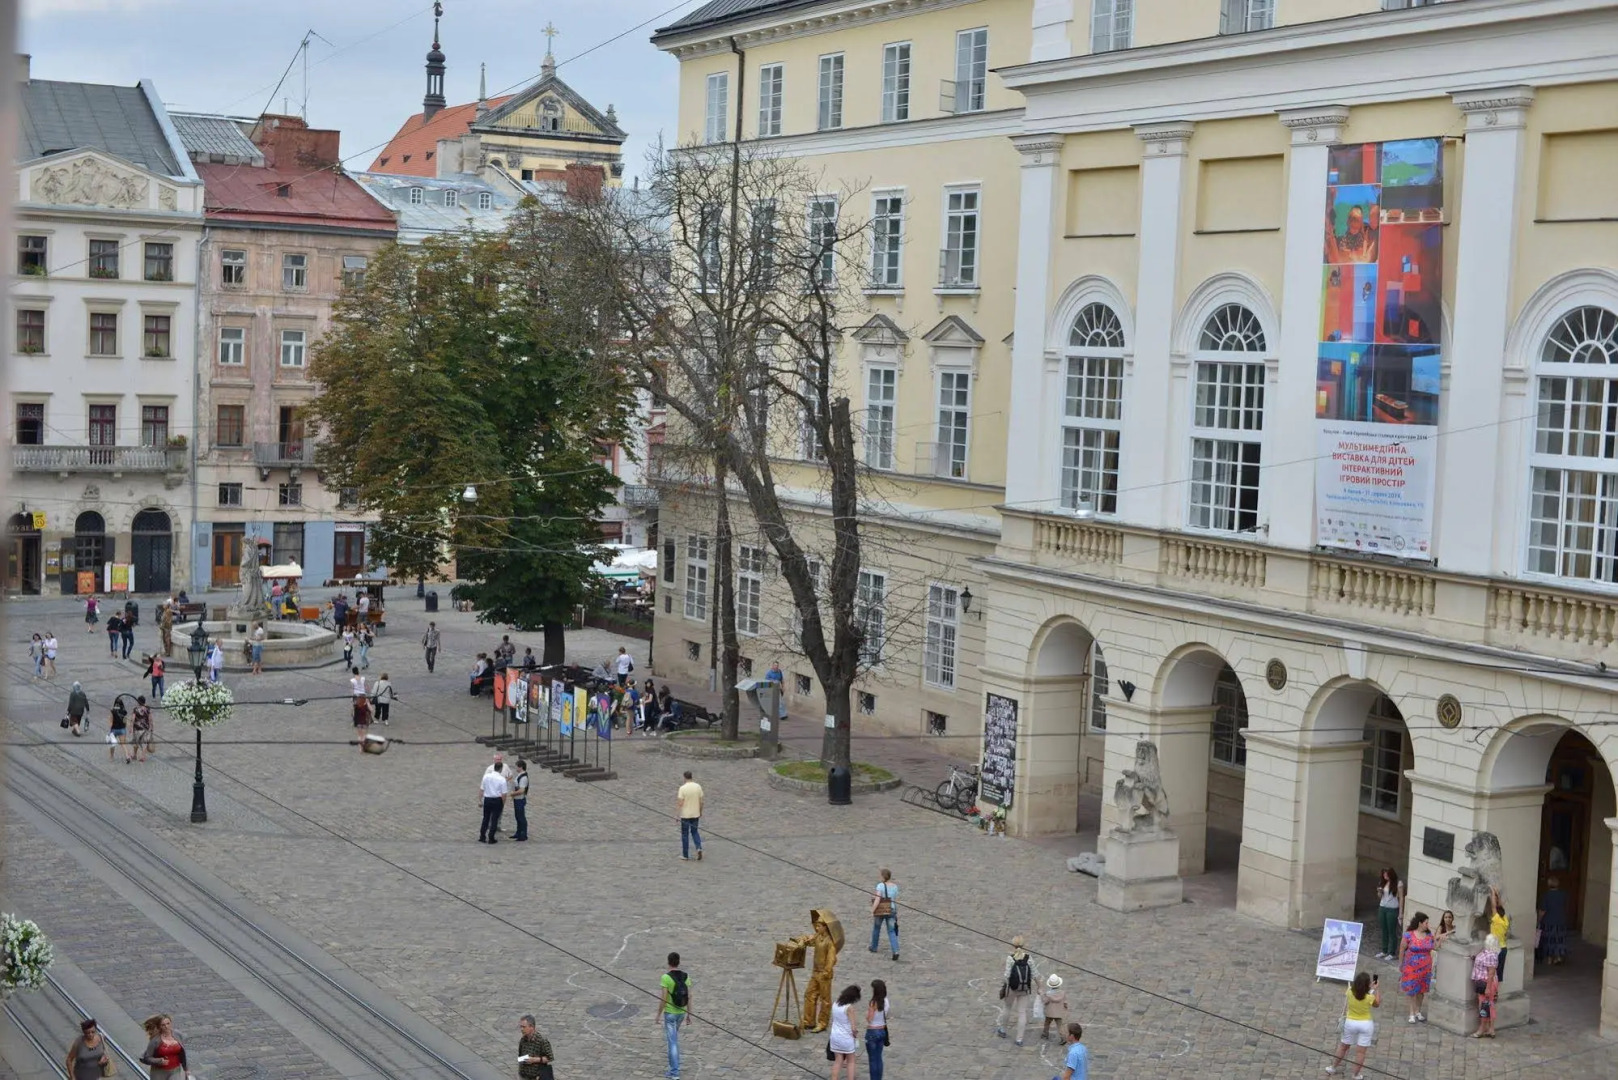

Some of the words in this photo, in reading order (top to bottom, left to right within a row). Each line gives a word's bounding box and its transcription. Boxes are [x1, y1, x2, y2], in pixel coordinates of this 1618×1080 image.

[1338, 441, 1407, 455] МУЛЬТИМЕДІЙНА
[1332, 452, 1369, 463] ВИСТАВКА
[1370, 455, 1387, 465] ДЛЯ
[1388, 456, 1415, 467] ДІТЕЙ
[1341, 464, 1403, 476] ІНТЕРАКТИВНИЙ
[1340, 474, 1371, 484] ІГРОВИЙ
[1372, 476, 1406, 487] ПРОСТІР
